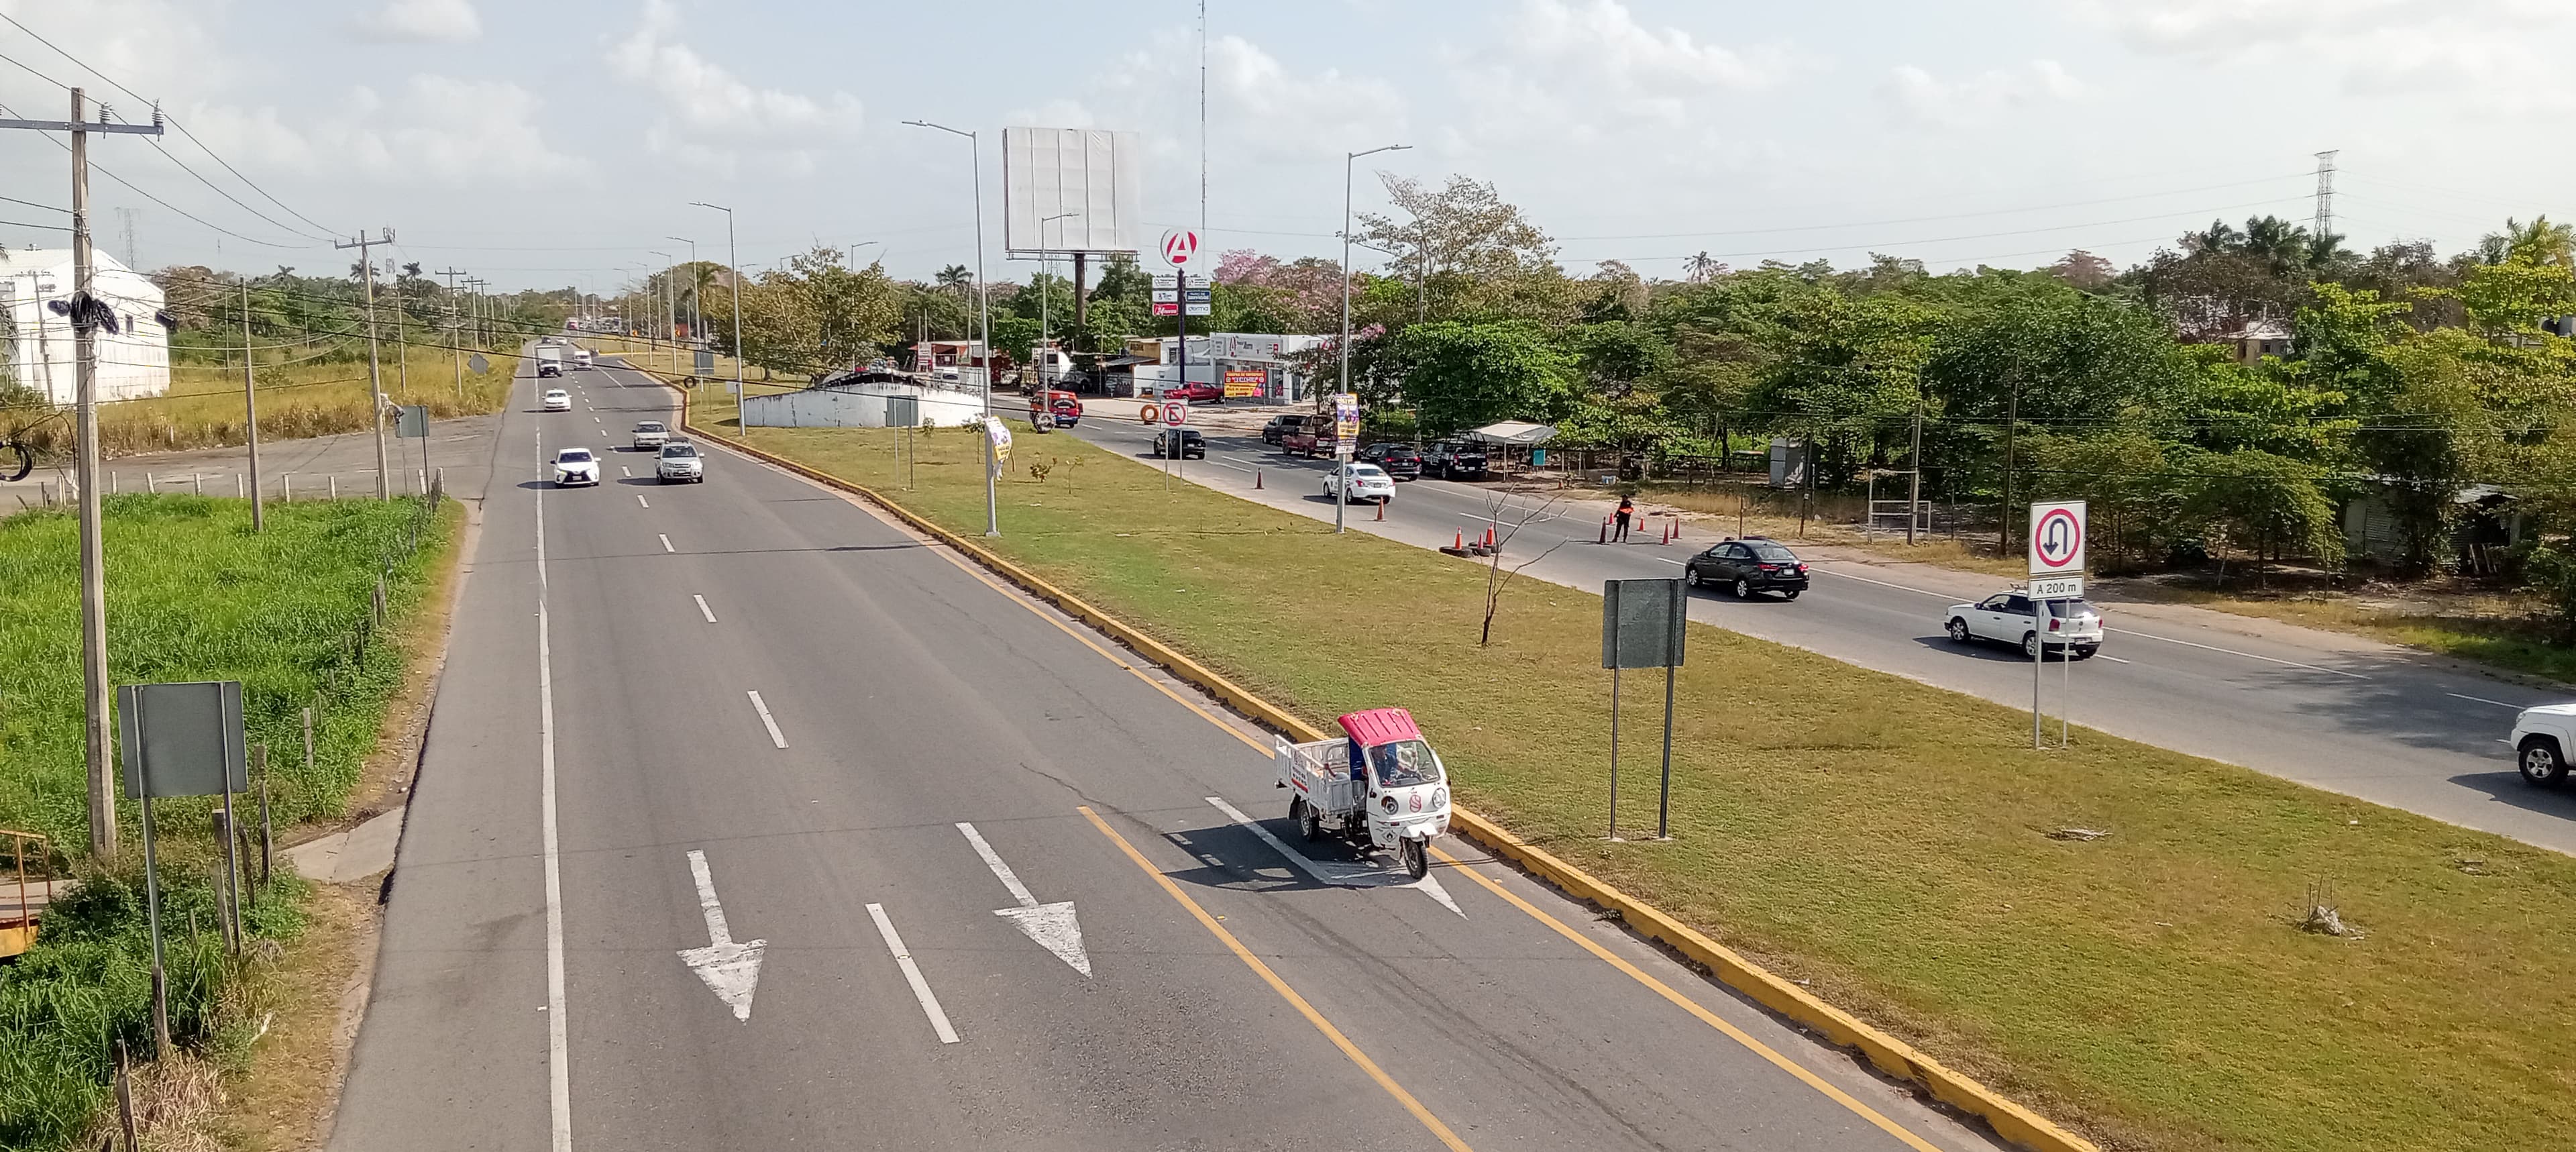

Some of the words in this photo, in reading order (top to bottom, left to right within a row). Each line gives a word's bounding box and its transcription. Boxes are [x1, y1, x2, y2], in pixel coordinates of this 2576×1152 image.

[2037, 585, 2043, 594] A
[2047, 582, 2065, 594] 200
[2068, 584, 2076, 592] m
